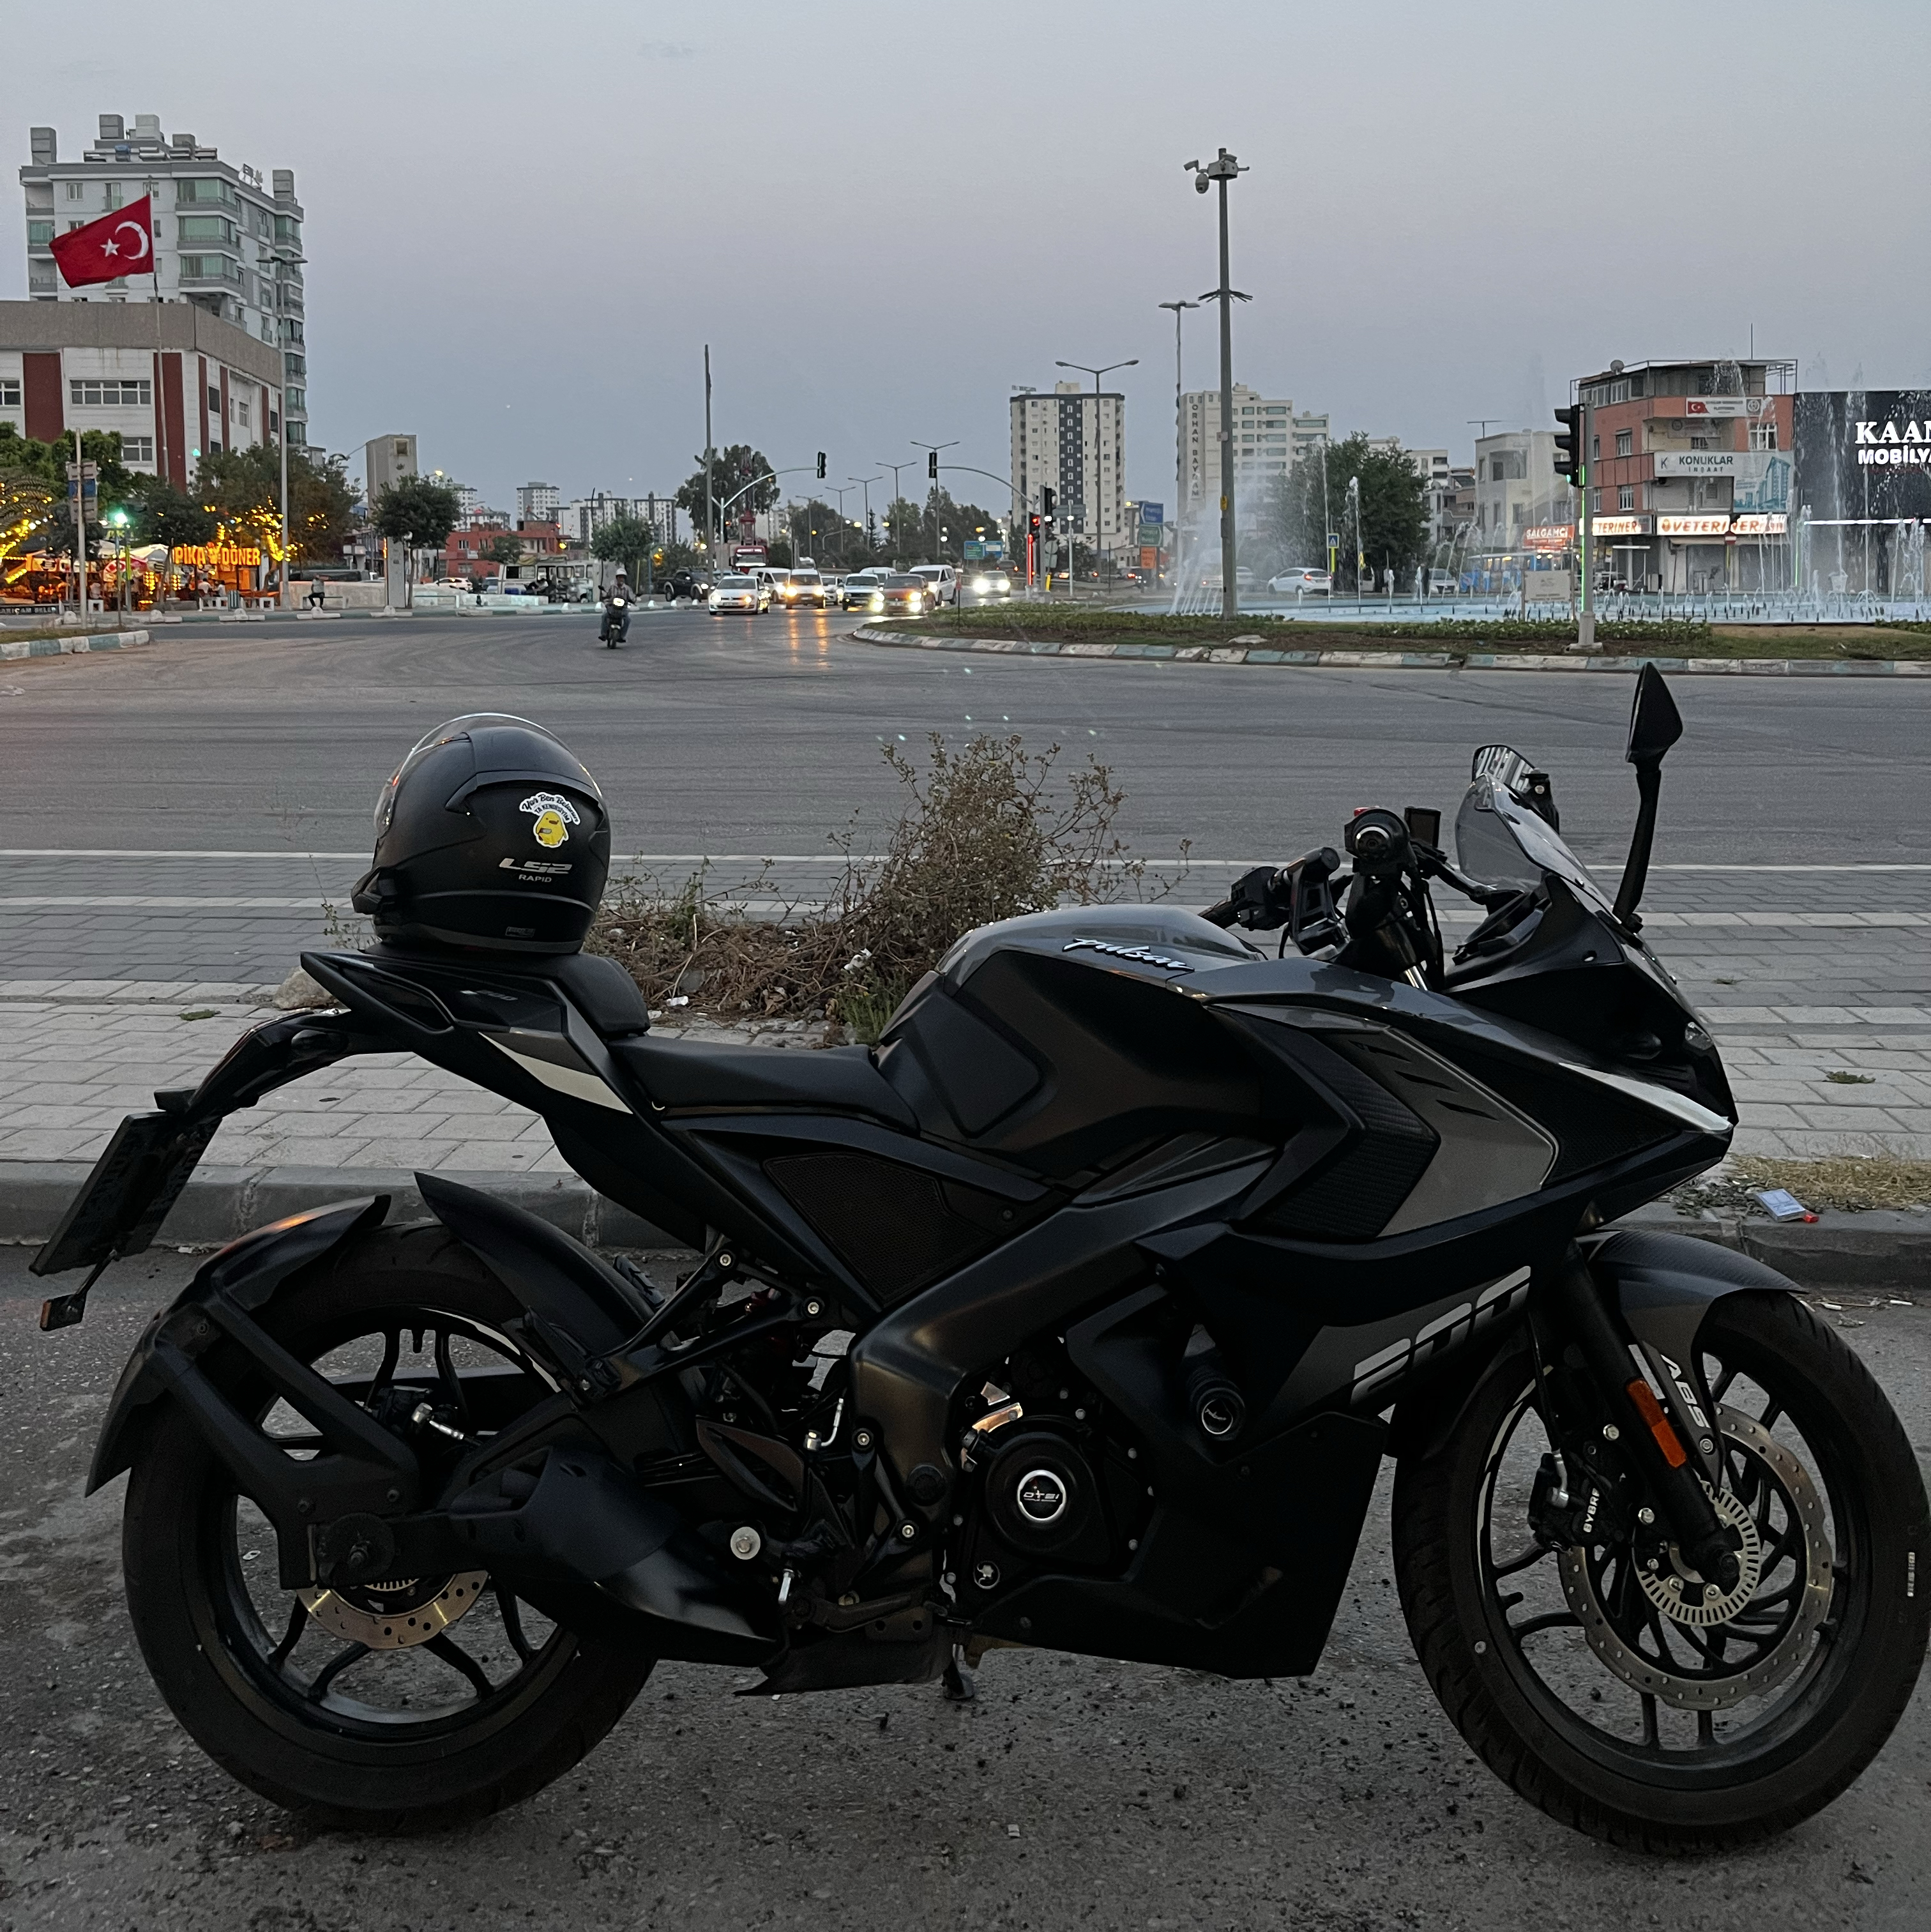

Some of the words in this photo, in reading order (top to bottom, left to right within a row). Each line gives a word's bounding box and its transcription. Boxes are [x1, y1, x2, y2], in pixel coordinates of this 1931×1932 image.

[1679, 455, 1734, 465] KONUKLAR
[1858, 445, 1931, 465] MOBİLY
[538, 793, 555, 802] Ben
[499, 858, 573, 874] LS2
[519, 874, 552, 883] RAPID
[1660, 1353, 1712, 1429] ABS
